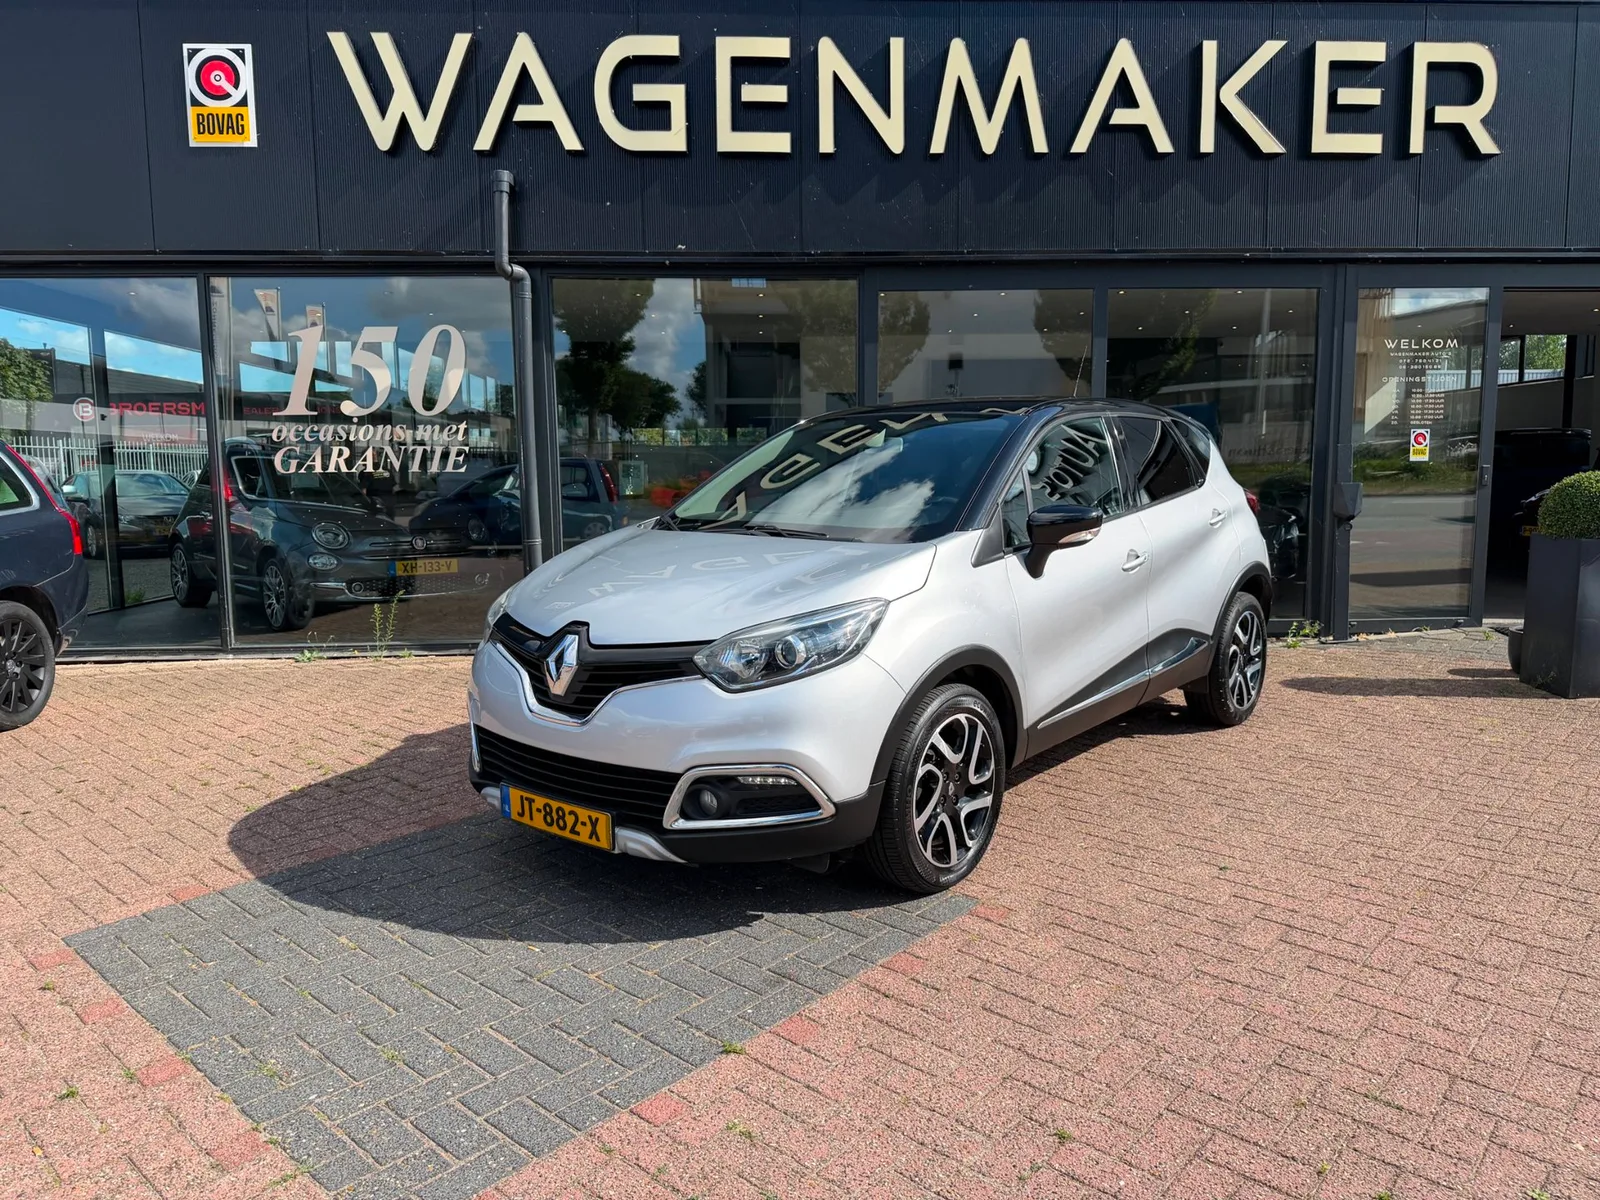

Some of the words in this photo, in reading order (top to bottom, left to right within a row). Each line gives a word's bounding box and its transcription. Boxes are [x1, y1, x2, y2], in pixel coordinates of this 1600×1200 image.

[326, 31, 1501, 155] WAGENMAKER
[196, 112, 245, 136] BOVAG
[1384, 338, 1459, 349] WELKOM
[272, 324, 466, 417] 150
[109, 402, 206, 416] BROERSM
[271, 416, 407, 443] occasions
[415, 420, 467, 443] met
[273, 445, 470, 474] GARANTIE
[401, 560, 452, 574] XH-133-V
[517, 794, 601, 842] JT-882-X
